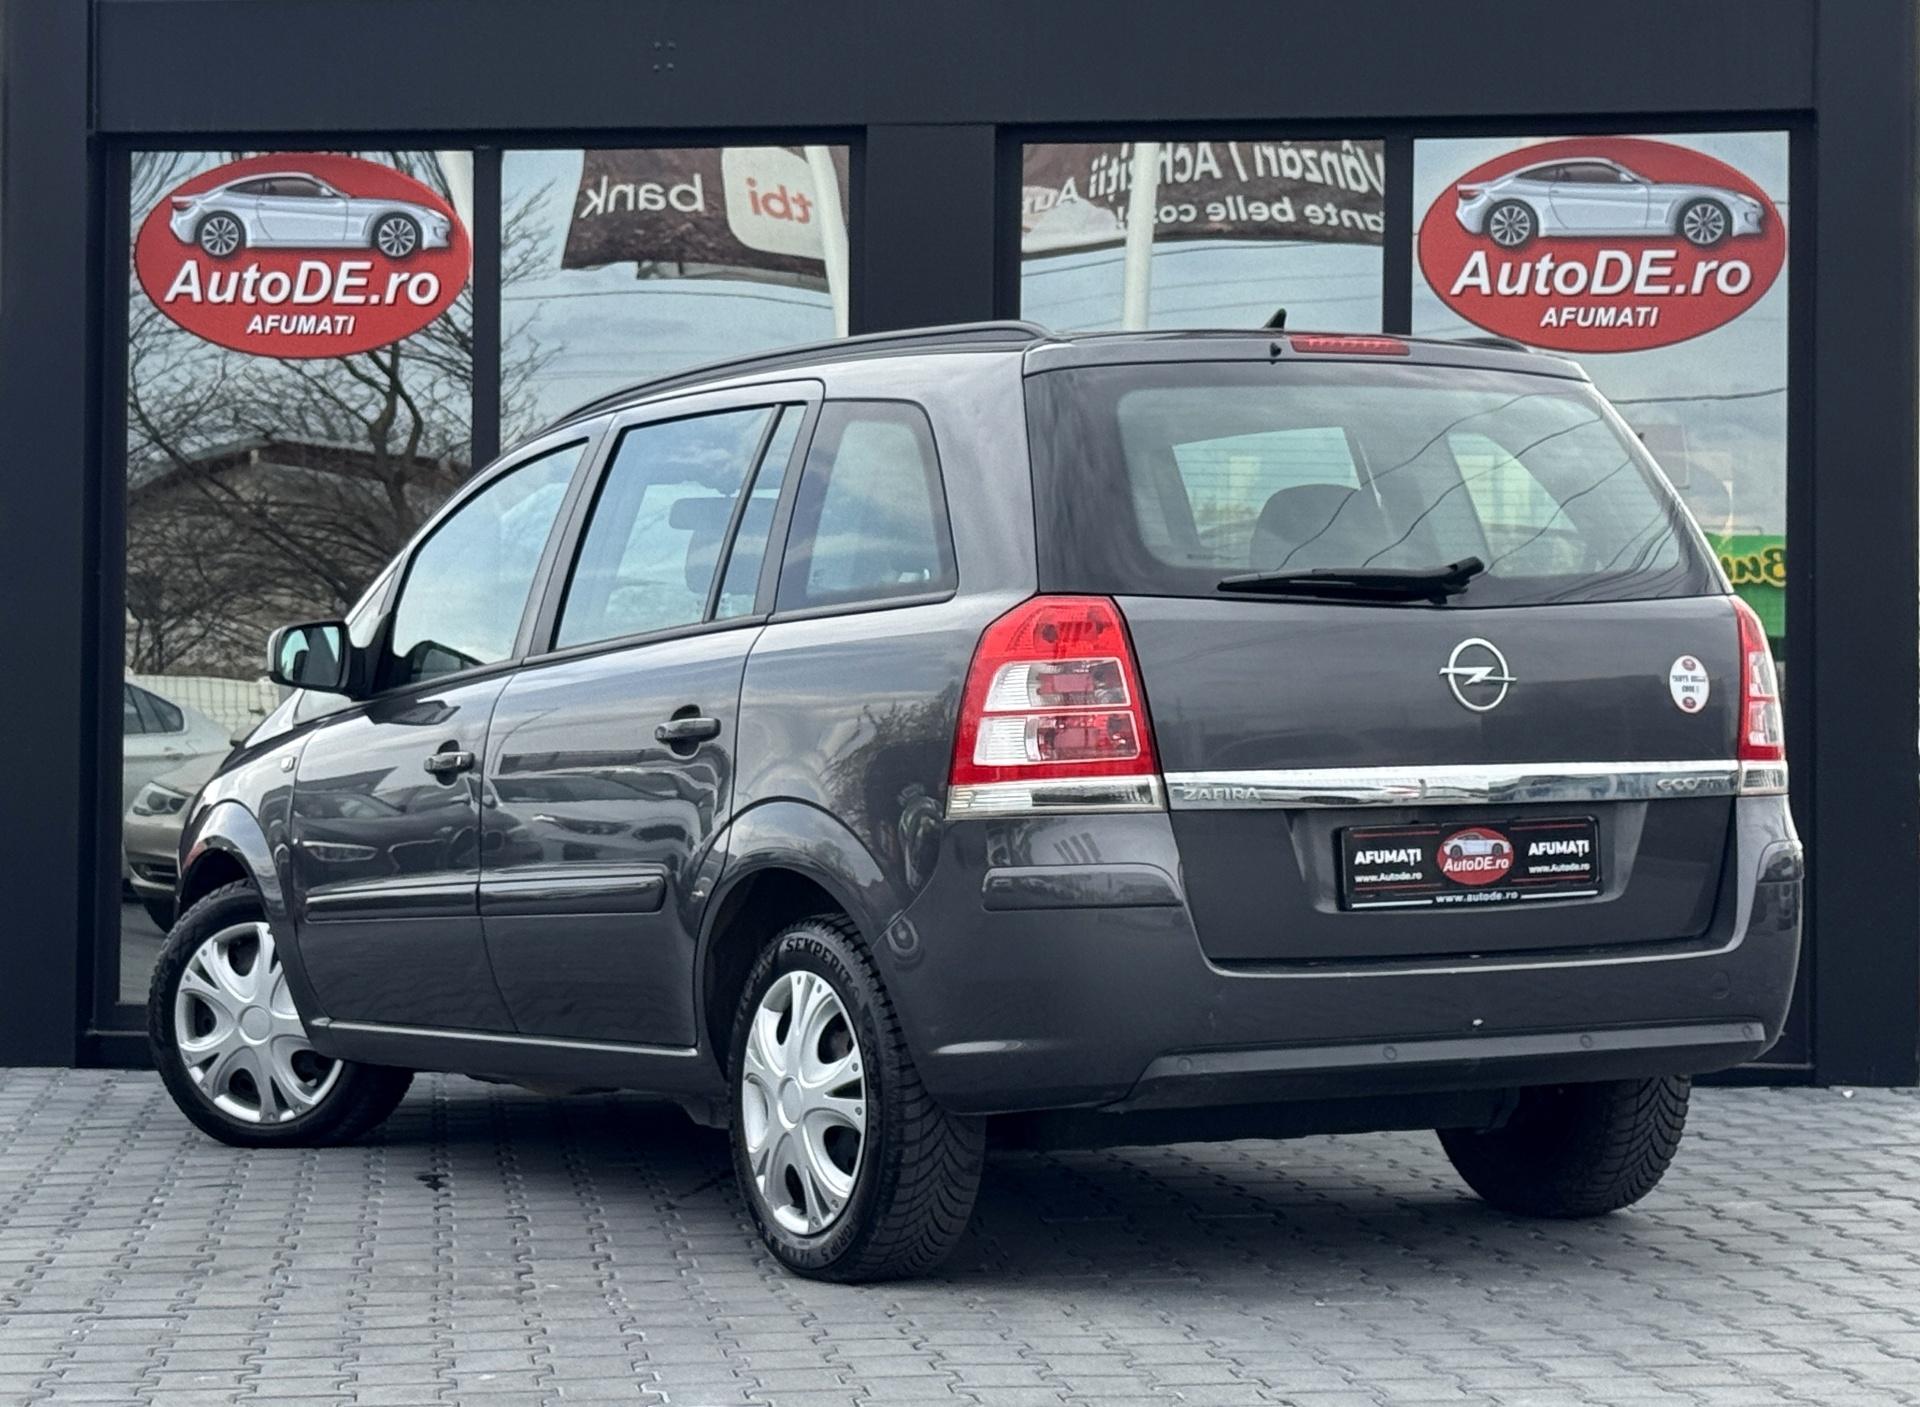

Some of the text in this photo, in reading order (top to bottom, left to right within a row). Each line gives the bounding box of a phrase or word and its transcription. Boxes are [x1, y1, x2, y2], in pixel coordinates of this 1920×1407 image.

[1450, 249, 1752, 297] AutoDE.ro
[164, 260, 440, 306] AutoDE.ro
[246, 314, 355, 336] AFUMATI
[1539, 306, 1659, 328] AFUMATI
[1183, 786, 1261, 801] ZAFIRA
[1443, 856, 1509, 873] AutoDE.ro
[1528, 862, 1590, 874] www.Autode.ro
[1354, 872, 1423, 883] www.Autode.ro
[1436, 891, 1519, 903] www.autode.ro
